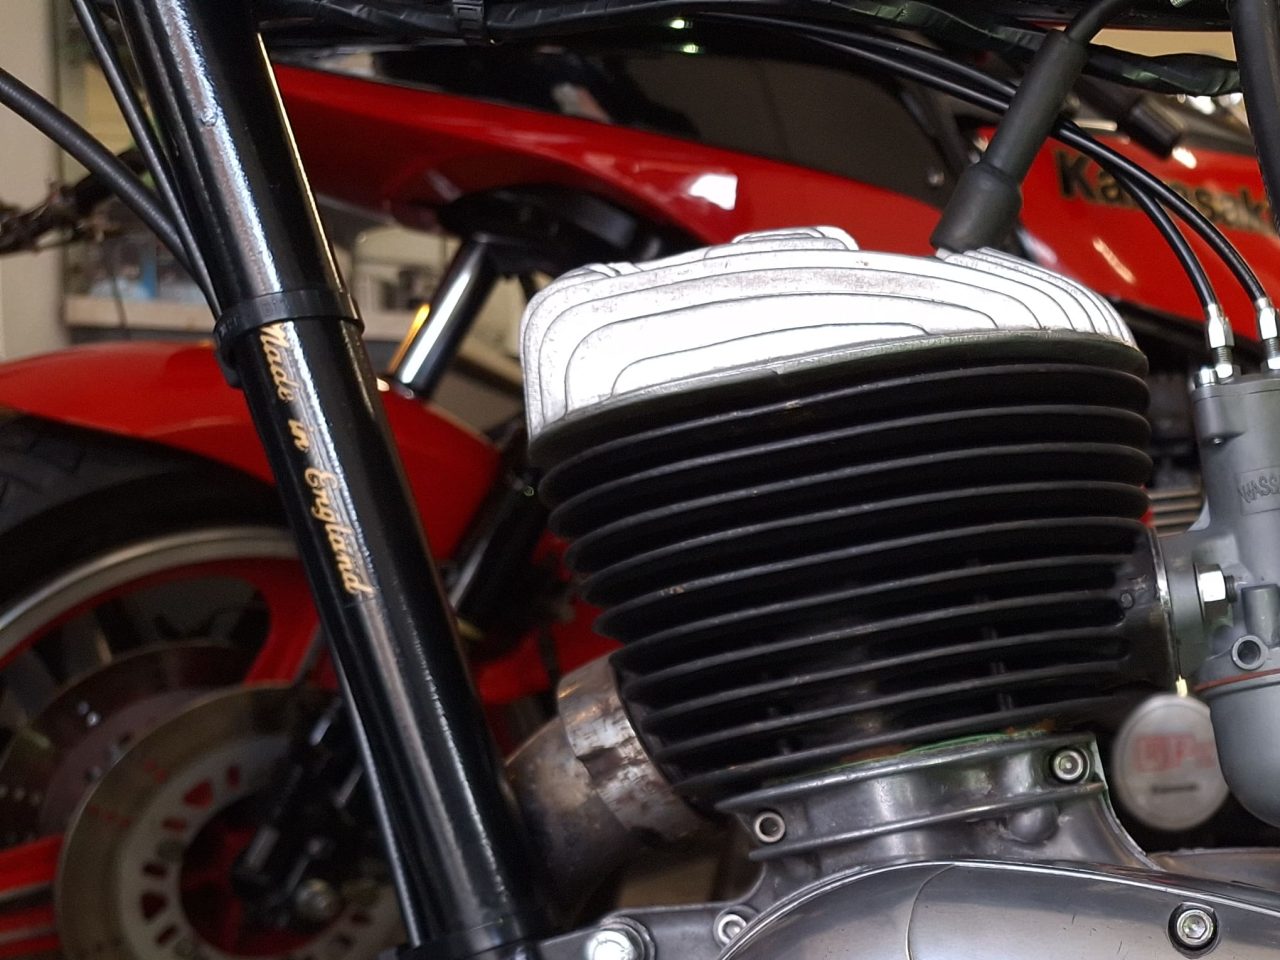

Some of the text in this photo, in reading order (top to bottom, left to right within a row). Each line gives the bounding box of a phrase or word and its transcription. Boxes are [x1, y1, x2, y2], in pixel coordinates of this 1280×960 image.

[259, 320, 375, 599] Made in England
